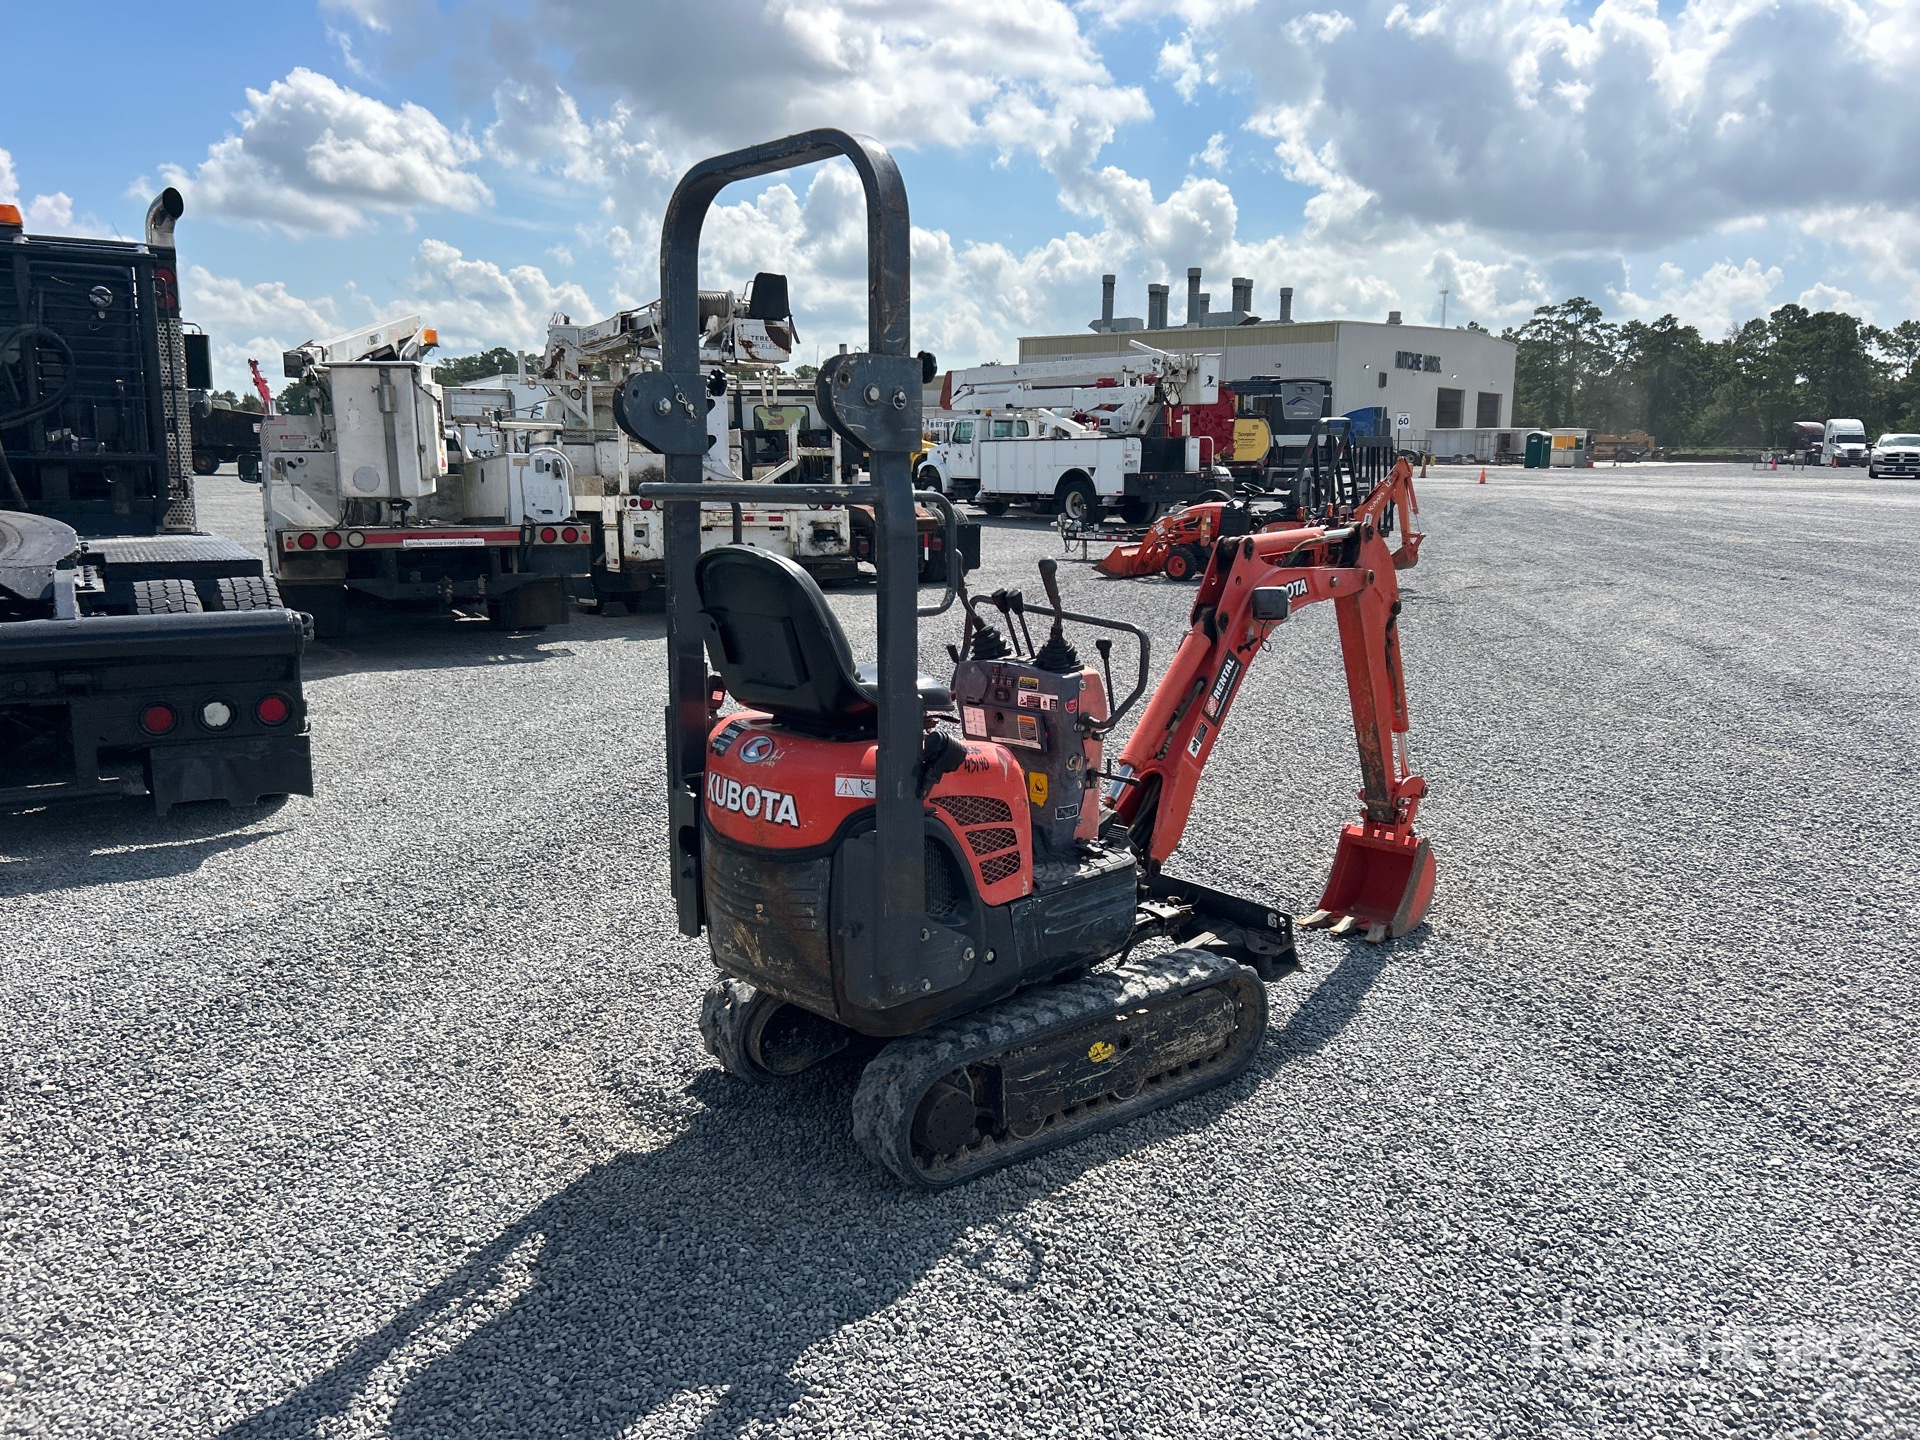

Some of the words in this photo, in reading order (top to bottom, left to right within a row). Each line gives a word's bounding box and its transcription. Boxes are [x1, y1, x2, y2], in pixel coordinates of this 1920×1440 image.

[1394, 350, 1423, 371] RITCHIE
[1398, 417, 1409, 426] 60
[1368, 491, 1385, 512] Kubota
[1286, 579, 1308, 598] OTA
[1213, 659, 1235, 700] RENTAL
[707, 771, 800, 827] KUBOTA
